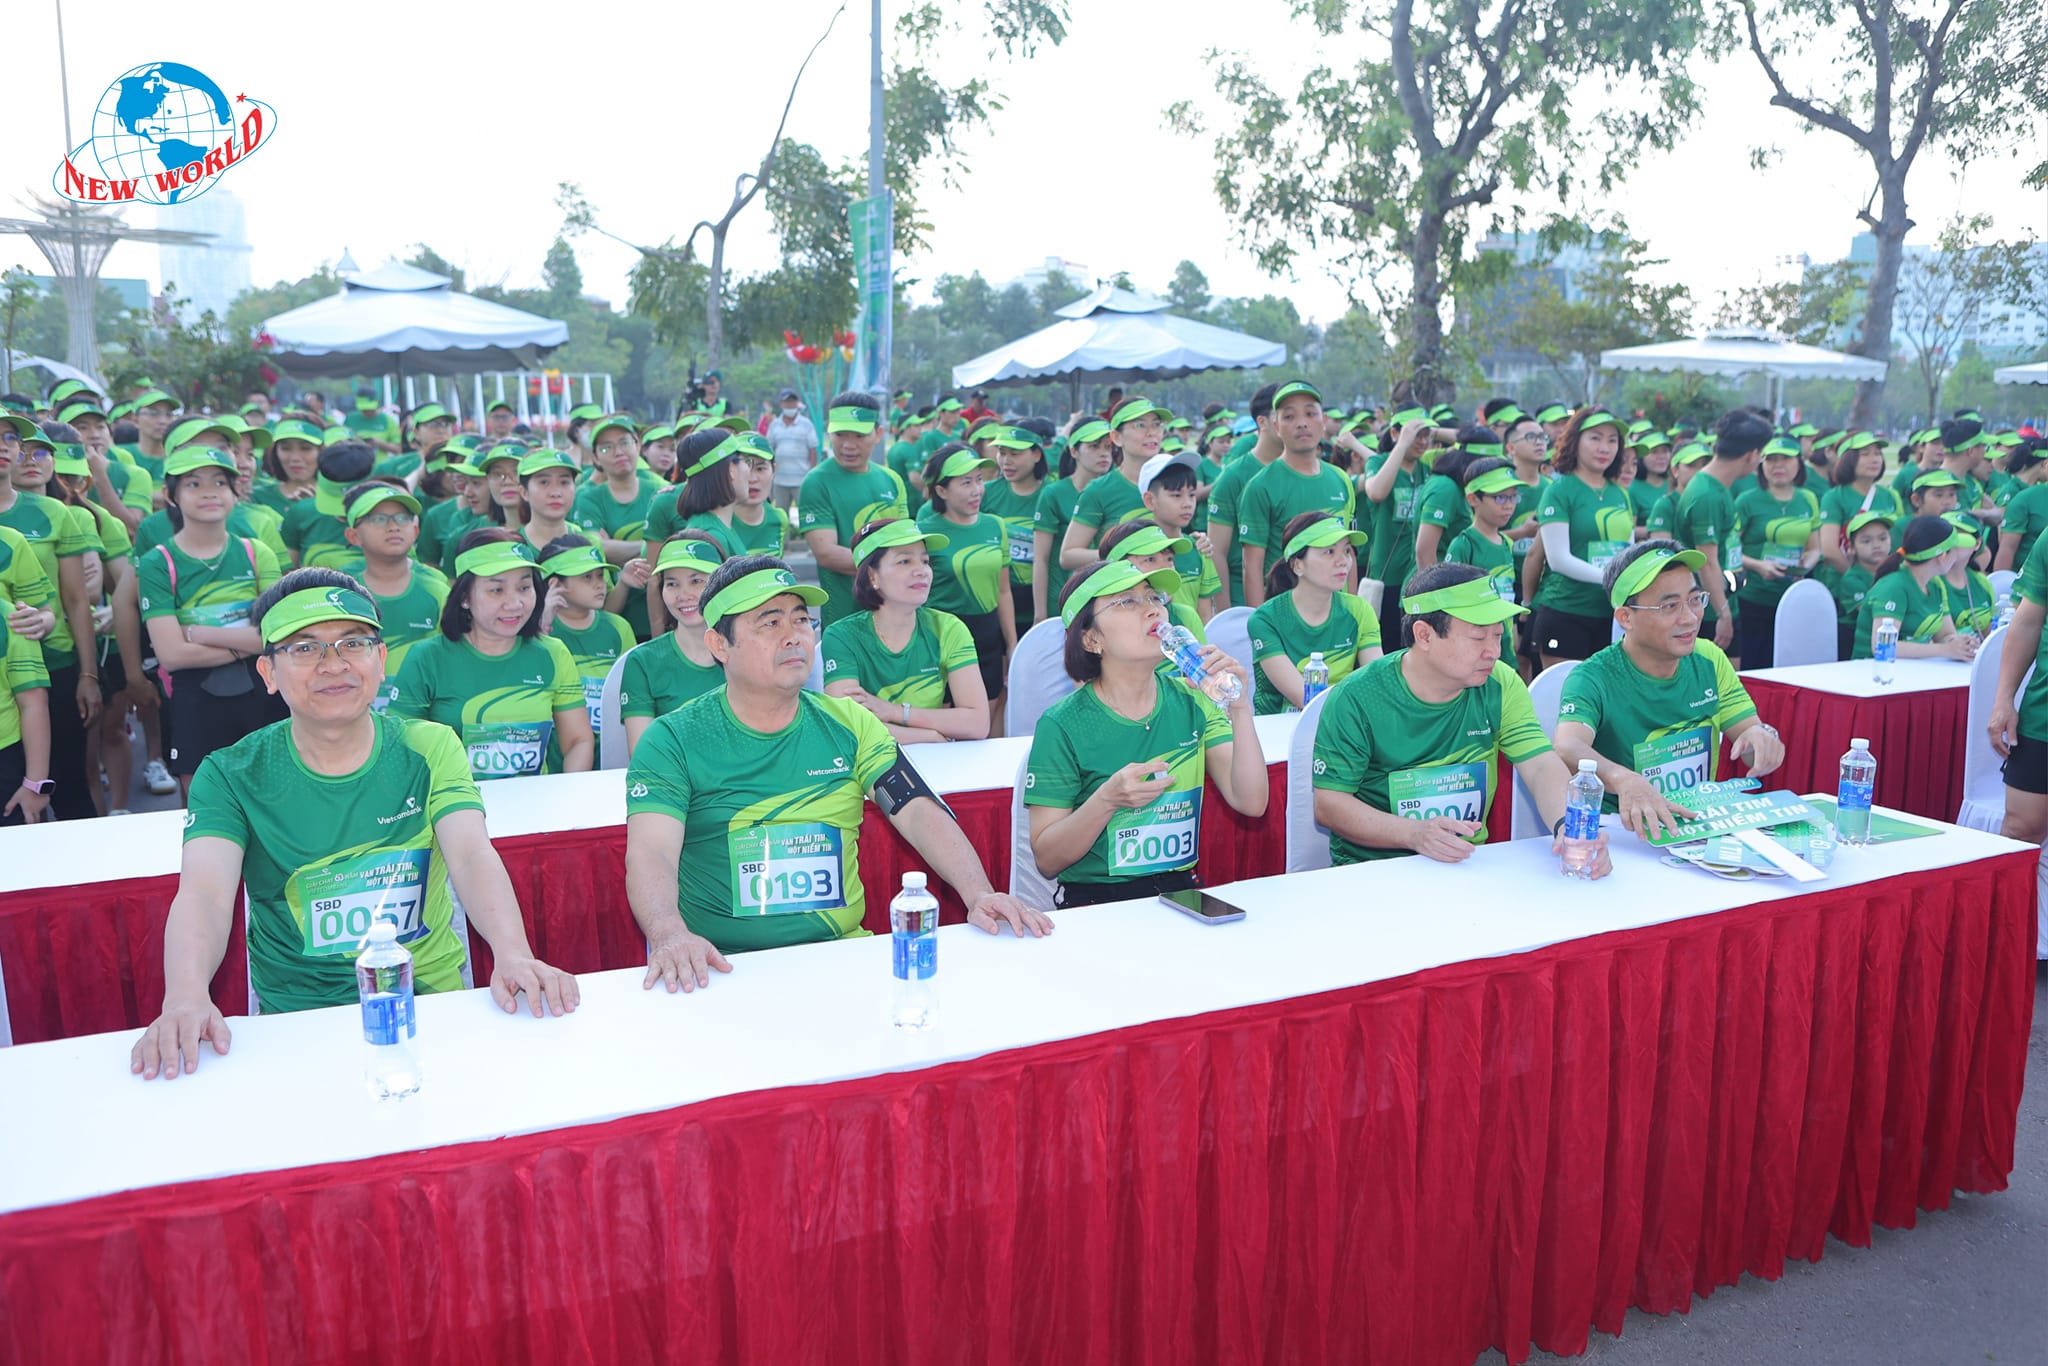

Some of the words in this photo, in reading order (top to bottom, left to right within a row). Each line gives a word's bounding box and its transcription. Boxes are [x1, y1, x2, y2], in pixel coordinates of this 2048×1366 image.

[473, 750, 537, 771] 0002
[1644, 767, 1662, 777] SBD
[1649, 764, 1703, 793] 0001
[1400, 800, 1421, 810] SBD
[1731, 797, 1774, 812] TIM
[1769, 804, 1809, 818] TIN
[377, 805, 422, 824] Vietcombank
[1118, 829, 1139, 839] SBD
[1120, 830, 1192, 863] 0003
[742, 863, 766, 874] SBD
[750, 869, 833, 902] 0193
[315, 899, 342, 912] SBD
[320, 900, 416, 940] 0057
